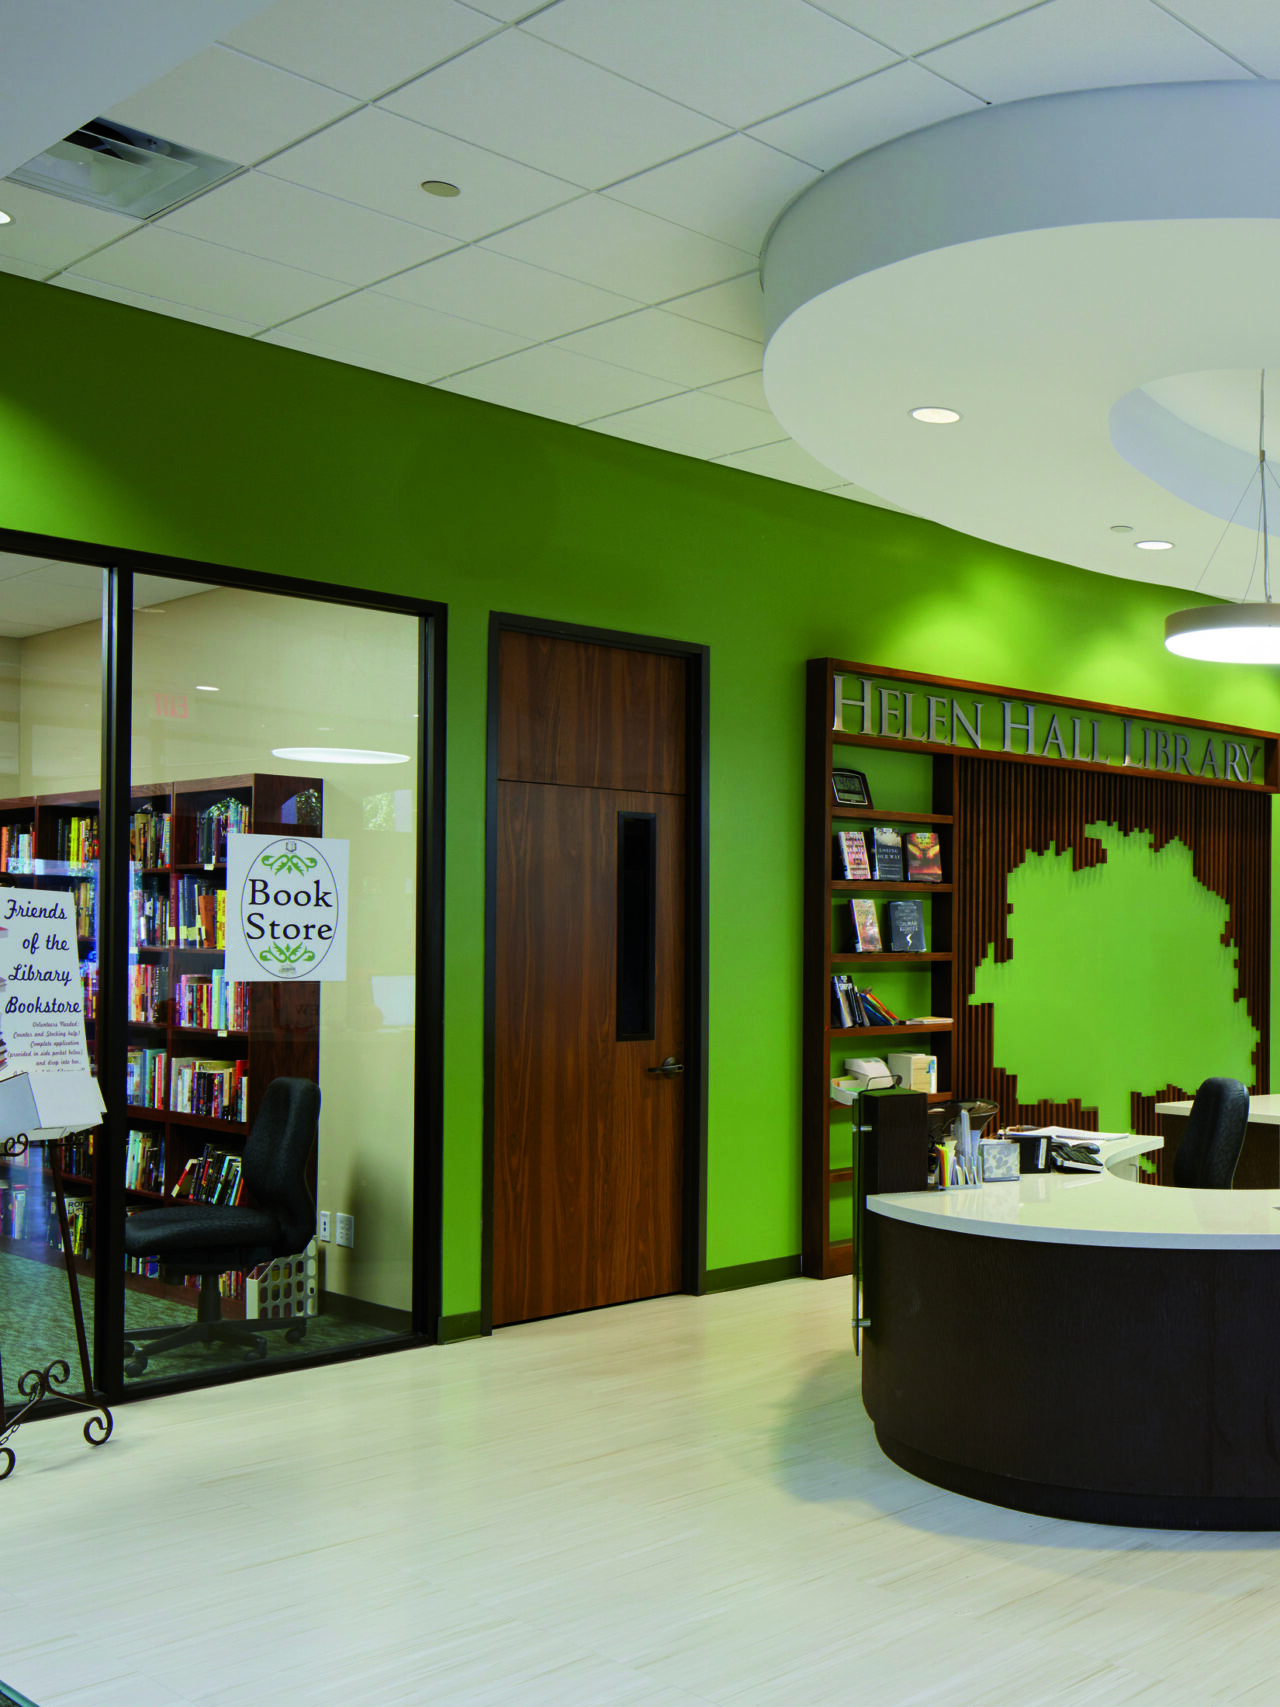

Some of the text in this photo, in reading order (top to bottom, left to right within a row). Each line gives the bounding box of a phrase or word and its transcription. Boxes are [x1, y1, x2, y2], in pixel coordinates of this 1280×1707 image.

[832, 675, 1261, 784] HELEN HALL LIBRARY
[248, 878, 333, 907] Book
[4, 899, 67, 919] Friends
[246, 912, 333, 940] Store
[22, 932, 70, 954] of the
[8, 963, 73, 987] Library
[5, 995, 82, 1014] Bookstore
